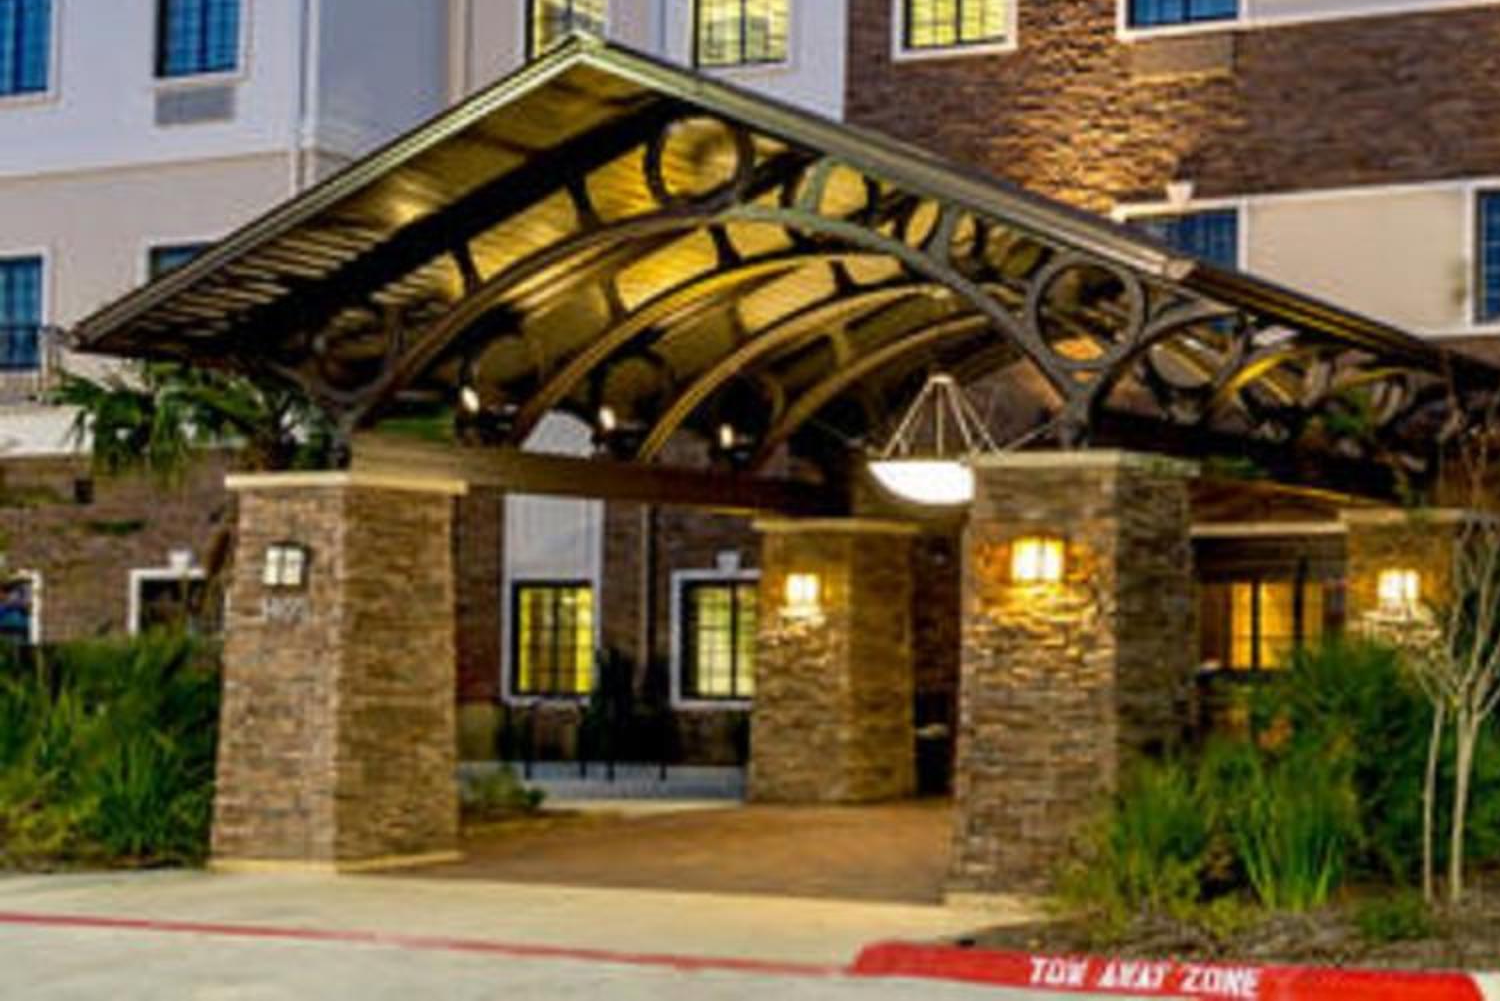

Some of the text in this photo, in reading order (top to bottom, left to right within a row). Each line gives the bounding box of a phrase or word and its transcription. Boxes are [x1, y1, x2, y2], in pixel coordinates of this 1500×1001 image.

[1029, 956, 1262, 996] TOW AWAY ZONE
